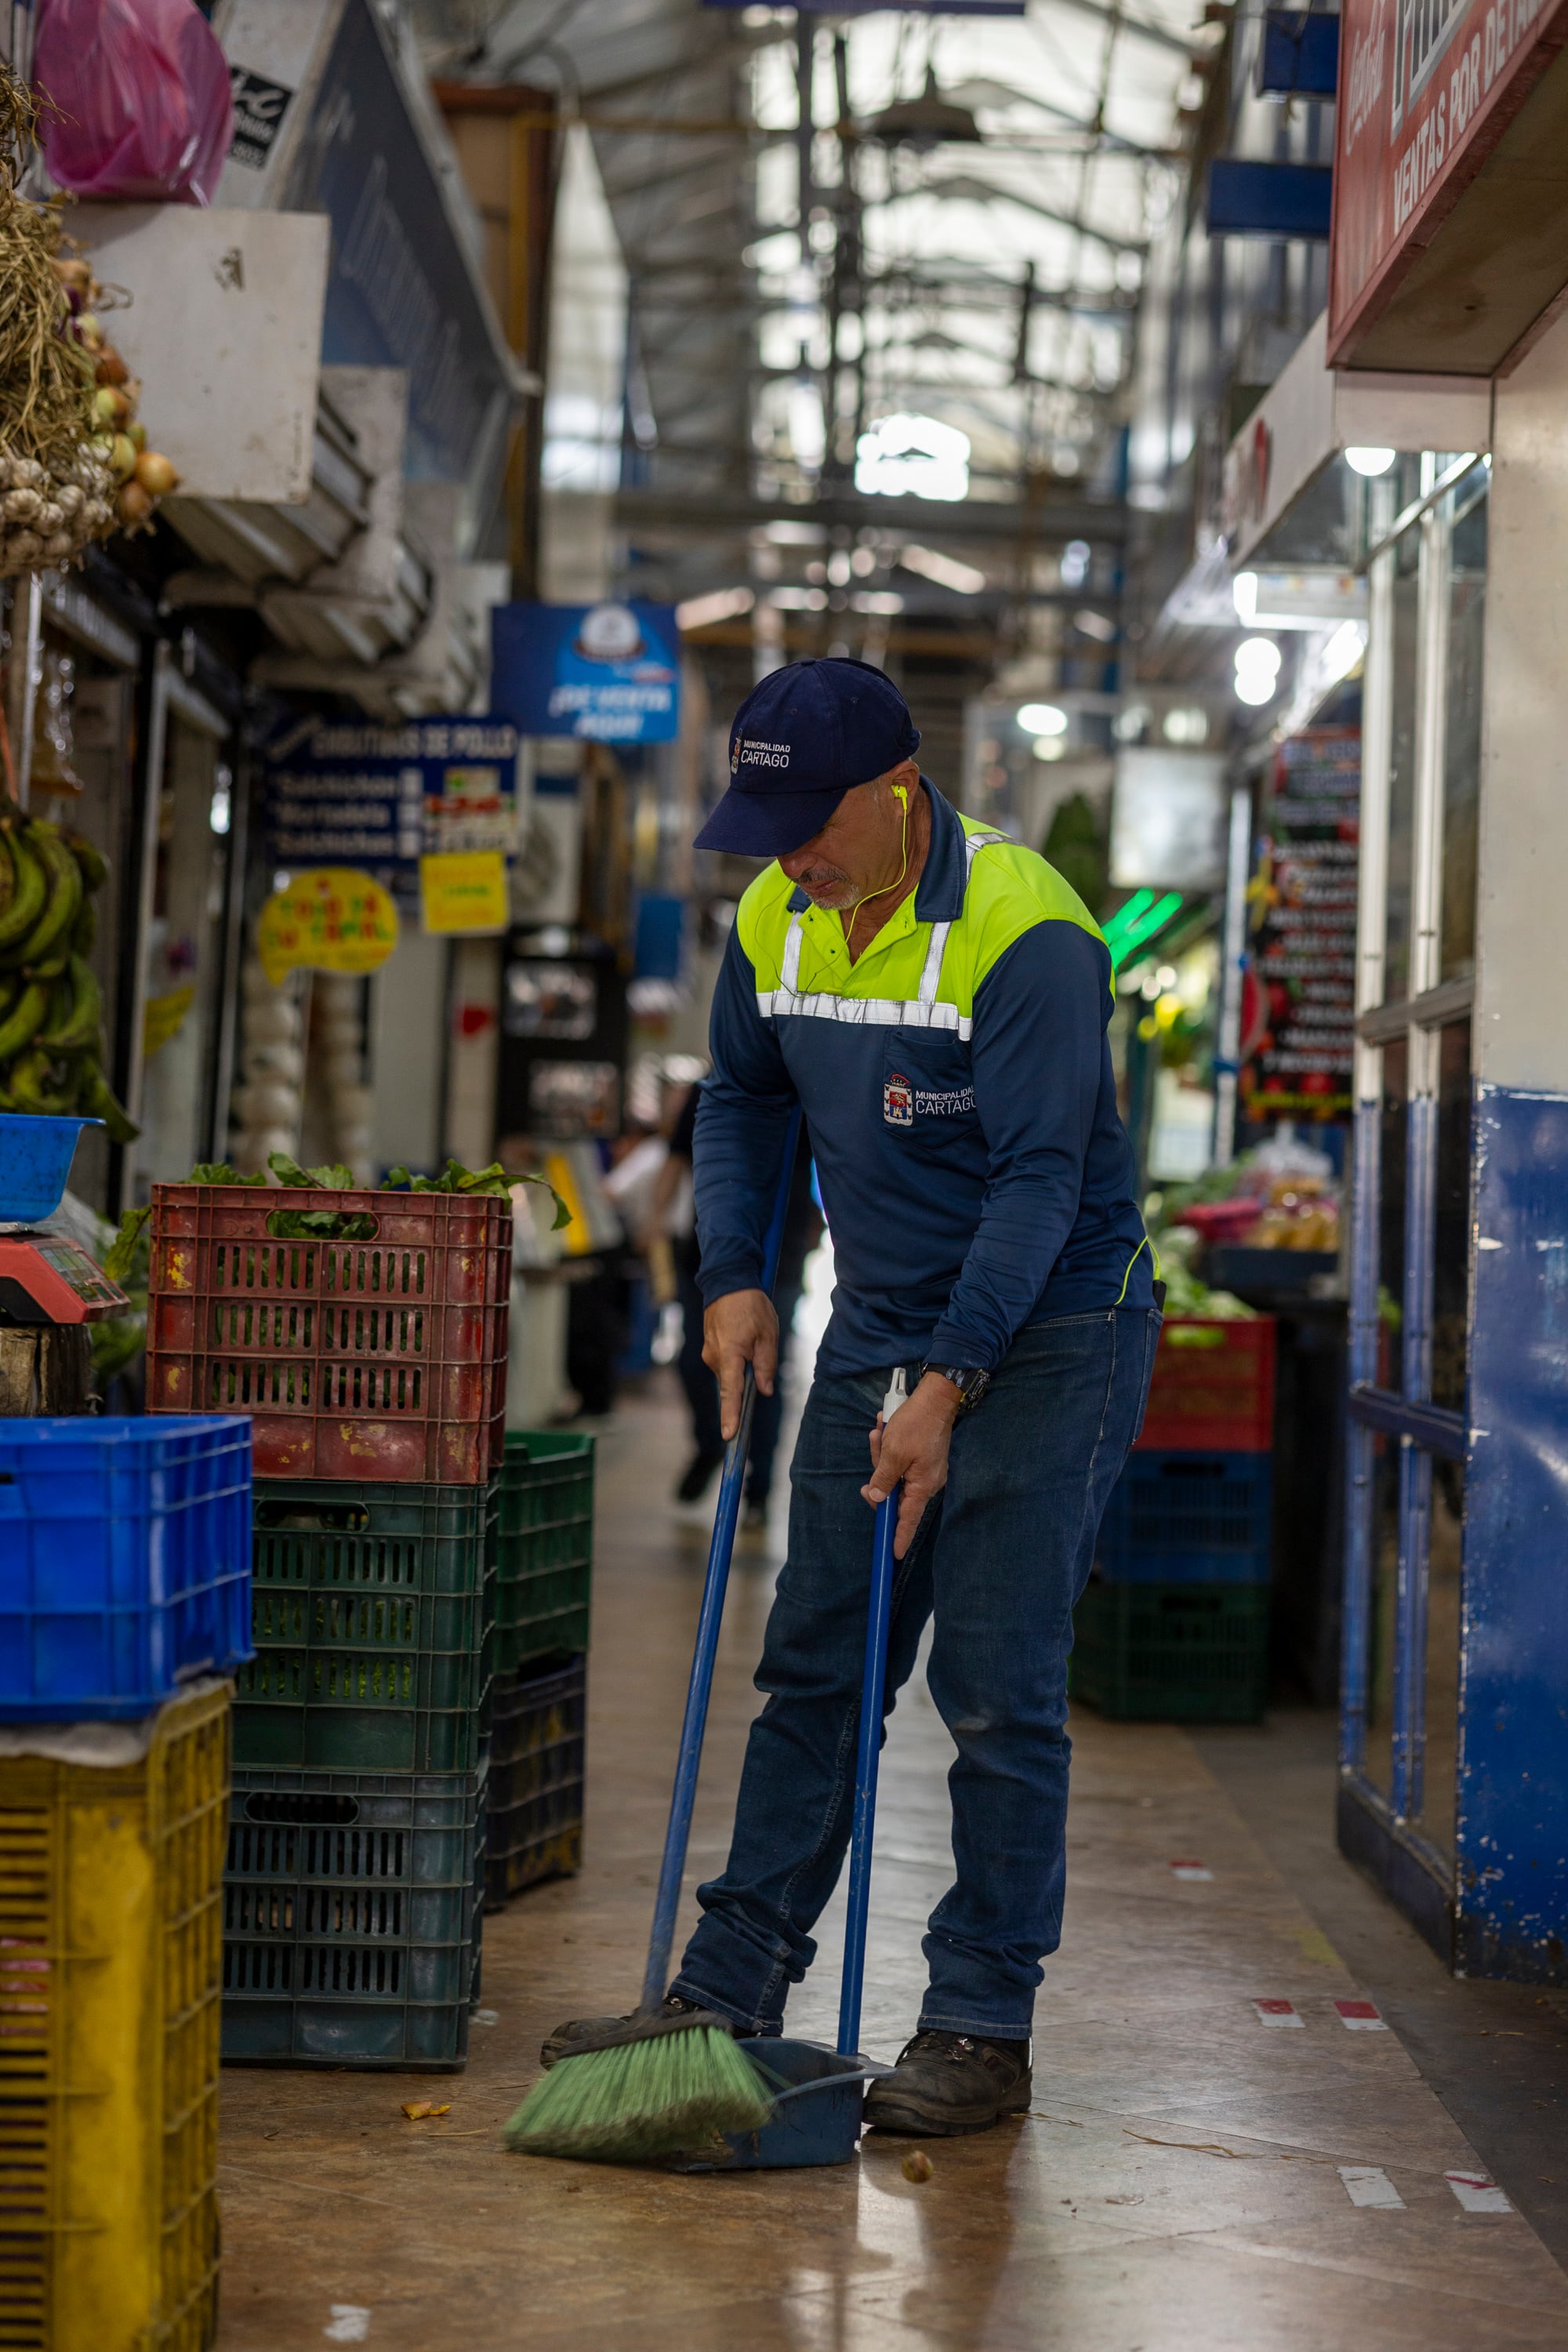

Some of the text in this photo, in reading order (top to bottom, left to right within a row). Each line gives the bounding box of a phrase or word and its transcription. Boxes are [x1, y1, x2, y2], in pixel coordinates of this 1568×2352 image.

[1393, 91, 1446, 235] VENTAS
[1448, 32, 1481, 150] POR
[743, 739, 791, 753] MUNICIPALIDAD
[740, 750, 789, 768] CARTAGO
[916, 1085, 974, 1101] MUNICIPALIDA
